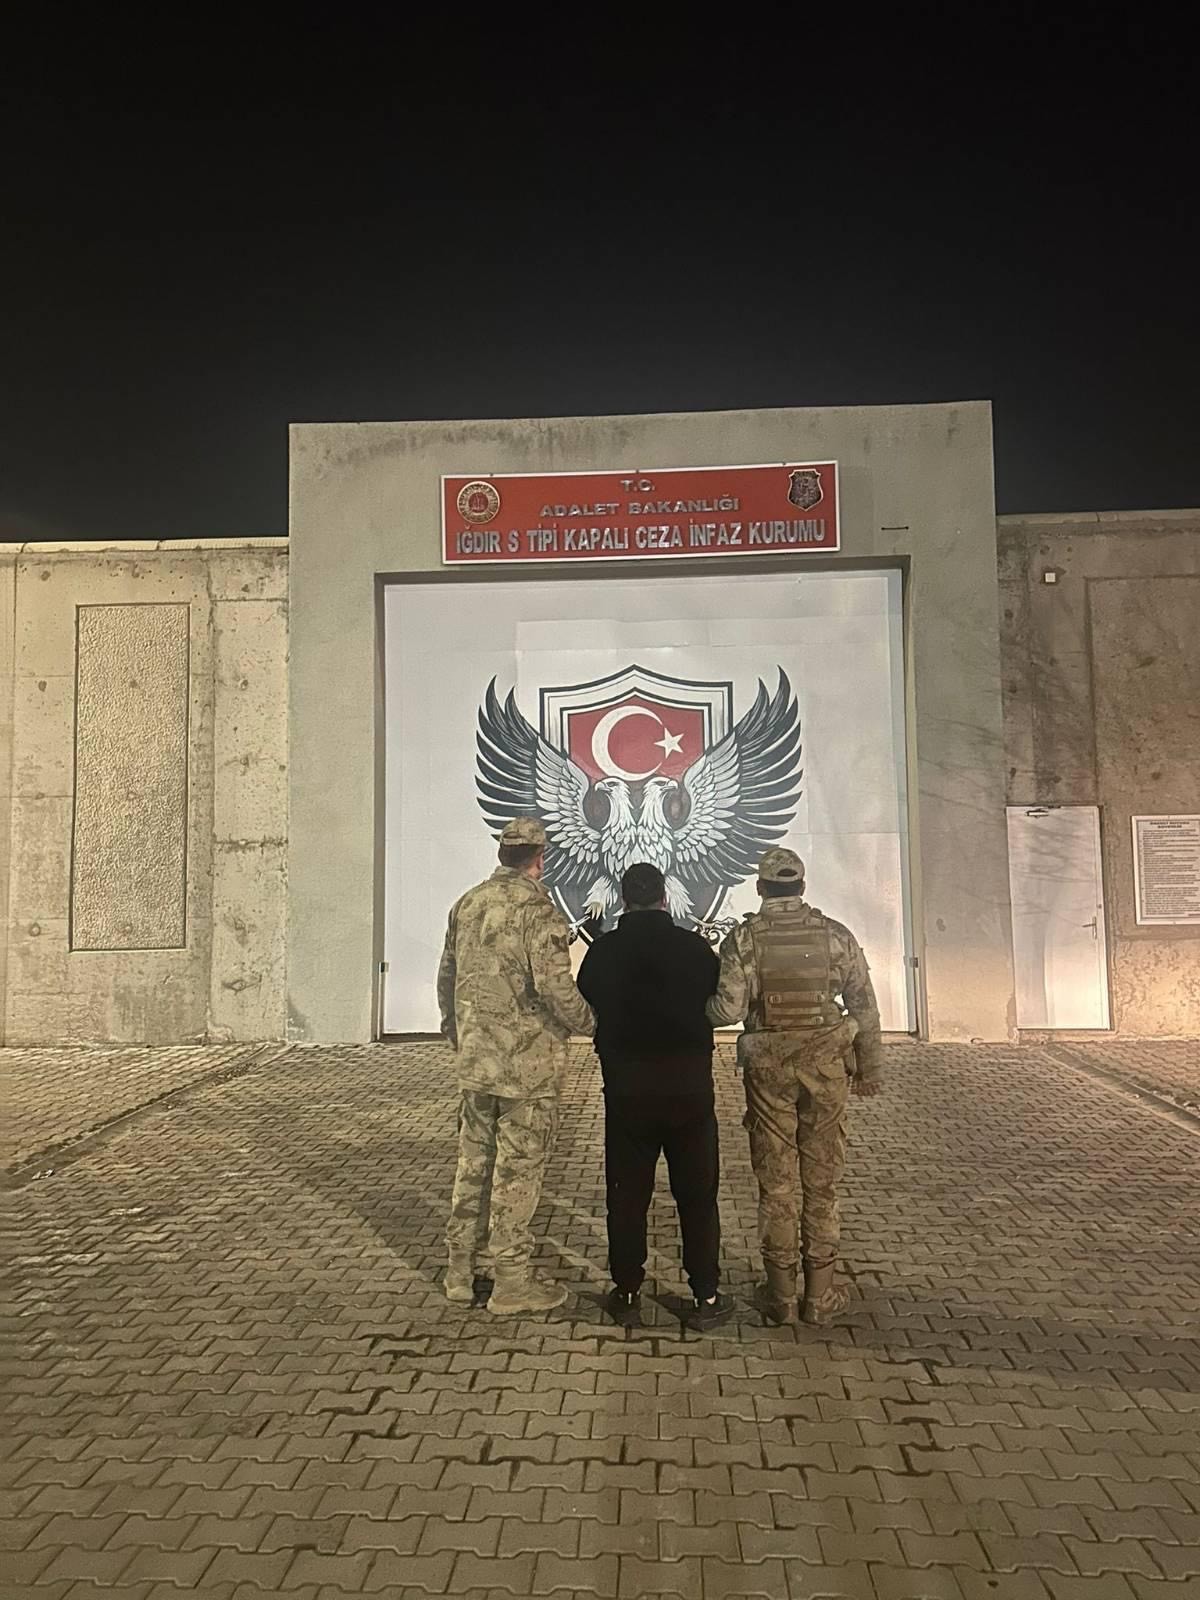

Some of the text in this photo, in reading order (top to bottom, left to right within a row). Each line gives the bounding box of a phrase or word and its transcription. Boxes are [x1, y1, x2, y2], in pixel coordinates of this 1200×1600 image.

[620, 479, 655, 492] T.C.
[540, 494, 739, 517] ADALET BAKANLIĞI
[456, 518, 826, 554] IĞDIR S TİPİ KAPALI CEZA İNFAZ KURUMU
